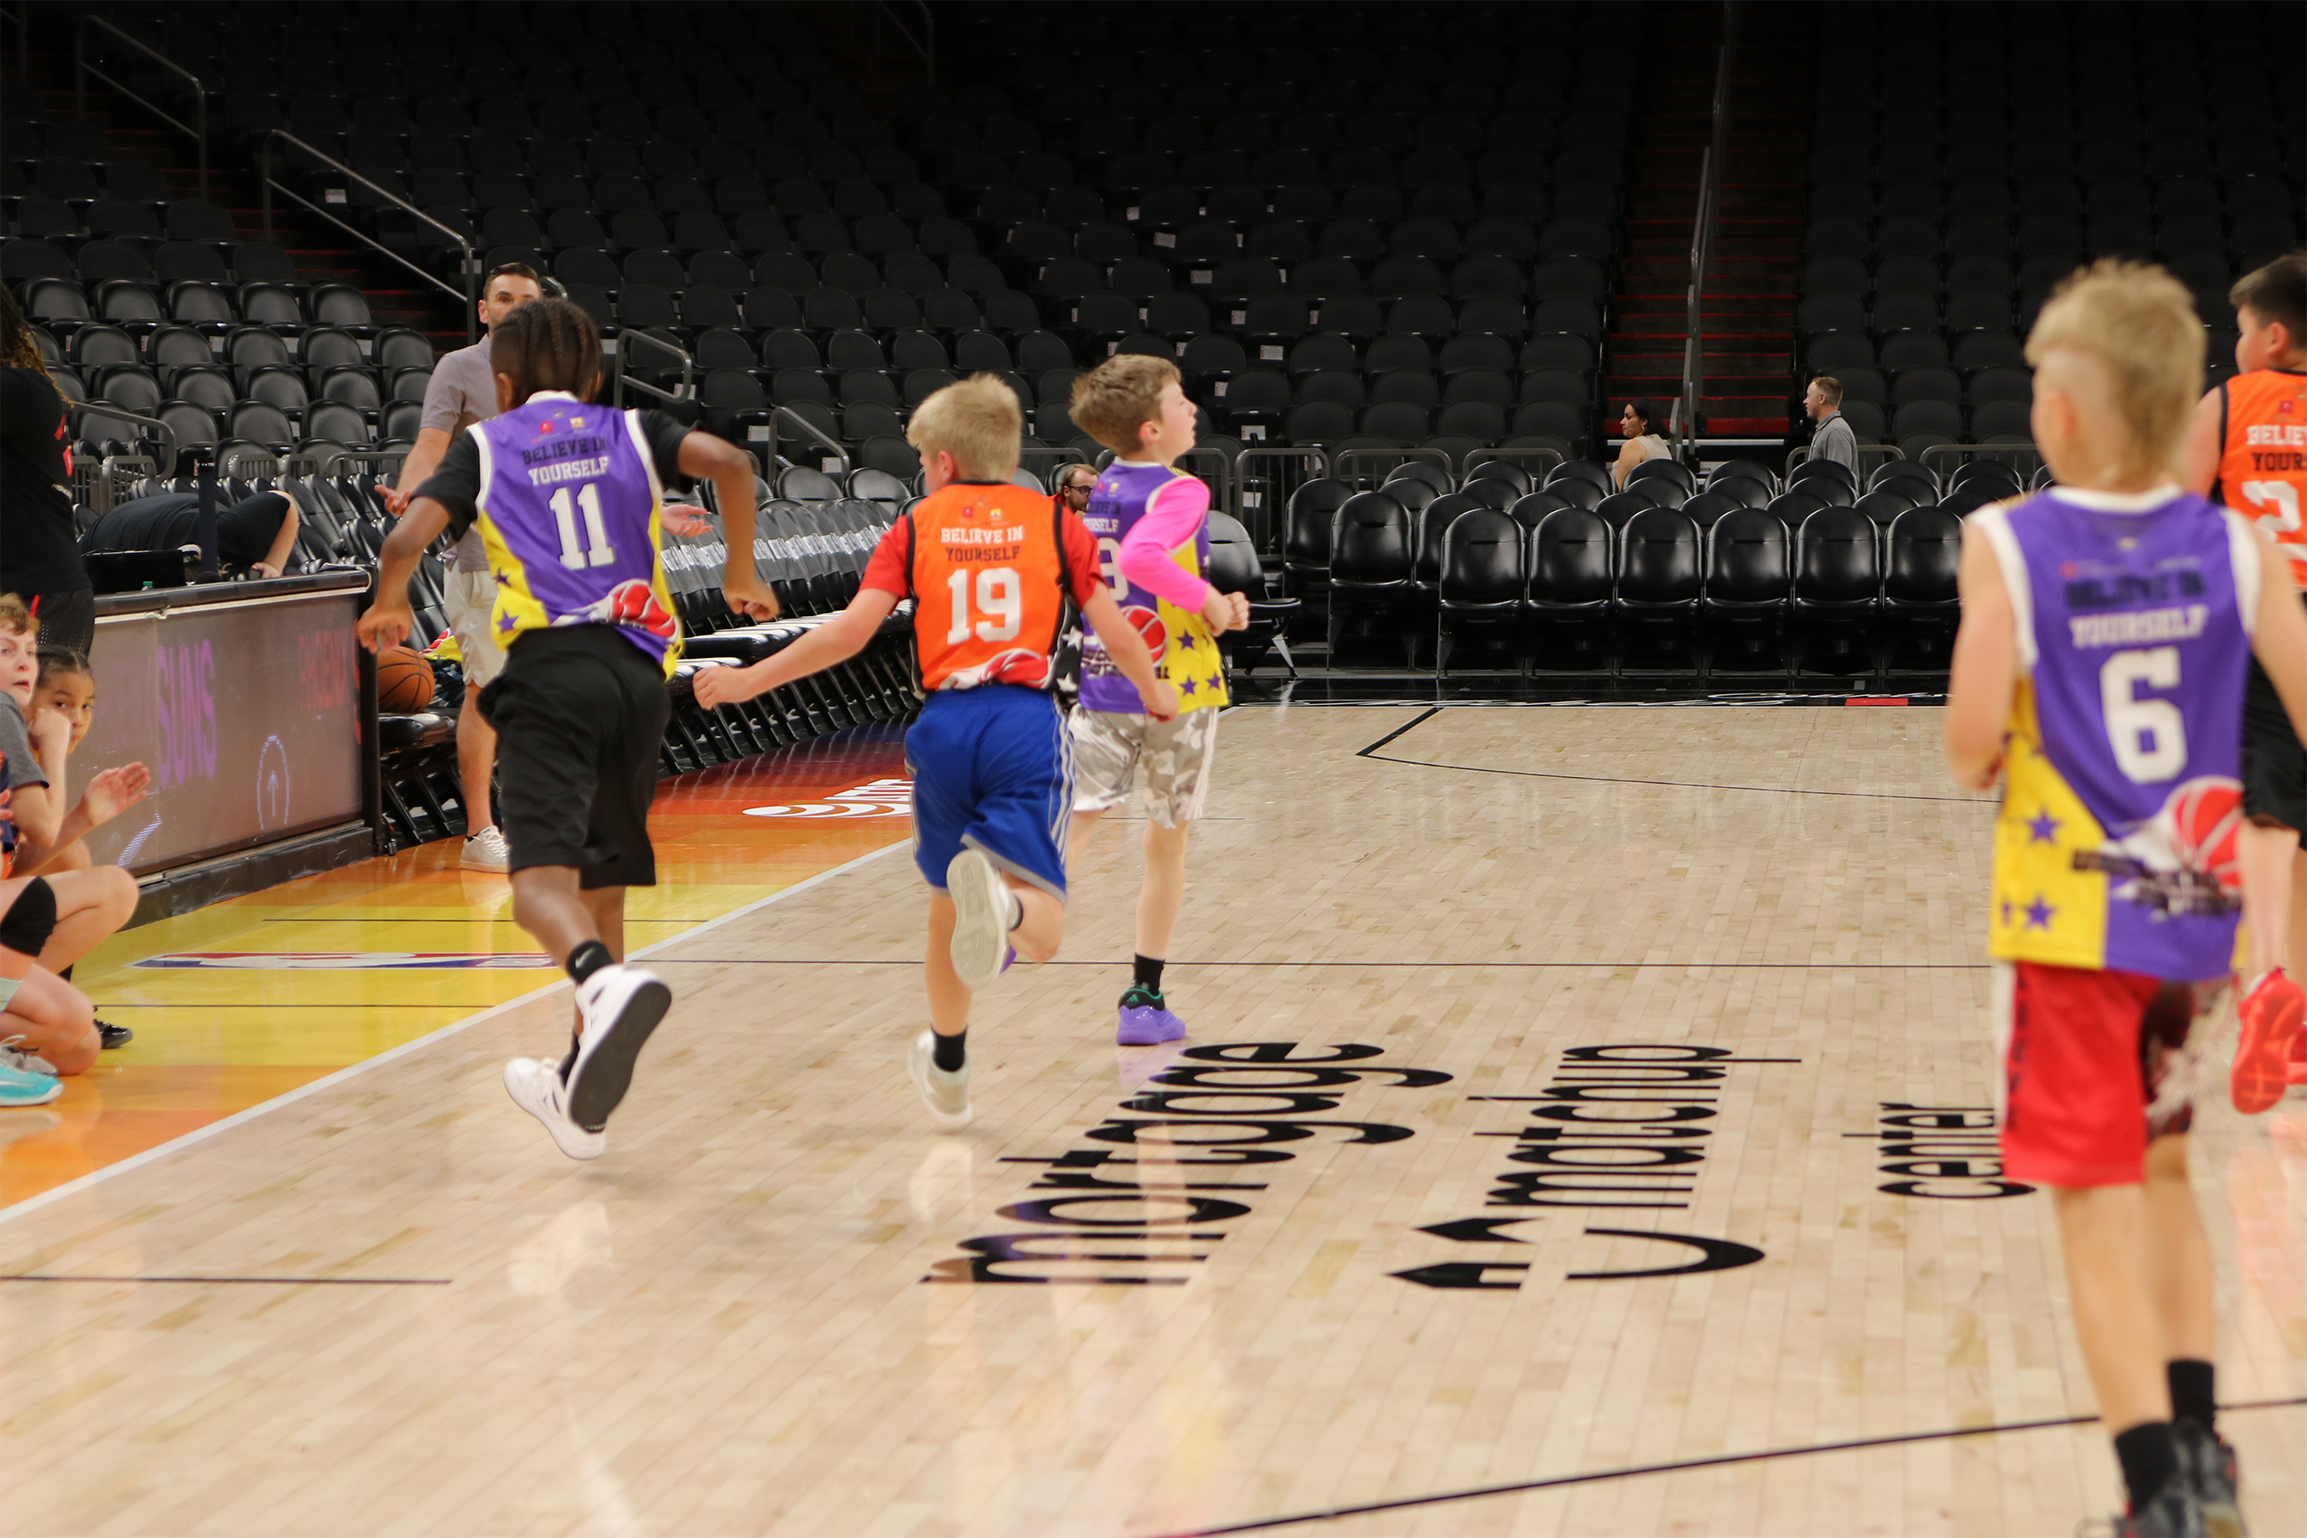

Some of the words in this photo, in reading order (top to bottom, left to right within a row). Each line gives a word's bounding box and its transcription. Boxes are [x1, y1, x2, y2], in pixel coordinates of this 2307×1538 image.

[522, 437, 588, 466] BELIEVE
[593, 436, 606, 452] IN
[528, 456, 610, 486] YOURSELF
[2252, 452, 2307, 472] YOUR
[549, 483, 616, 571] 11
[941, 527, 1003, 545] BELIEVE
[1007, 525, 1023, 543] IN
[945, 545, 1020, 563] YOURSELF
[947, 567, 1021, 645] 19
[157, 638, 217, 788] SUNS
[2099, 646, 2187, 783] 6
[919, 1043, 1454, 1285] mortgage
[1467, 1044, 1802, 1208] matchup
[1841, 1102, 2037, 1199] center
